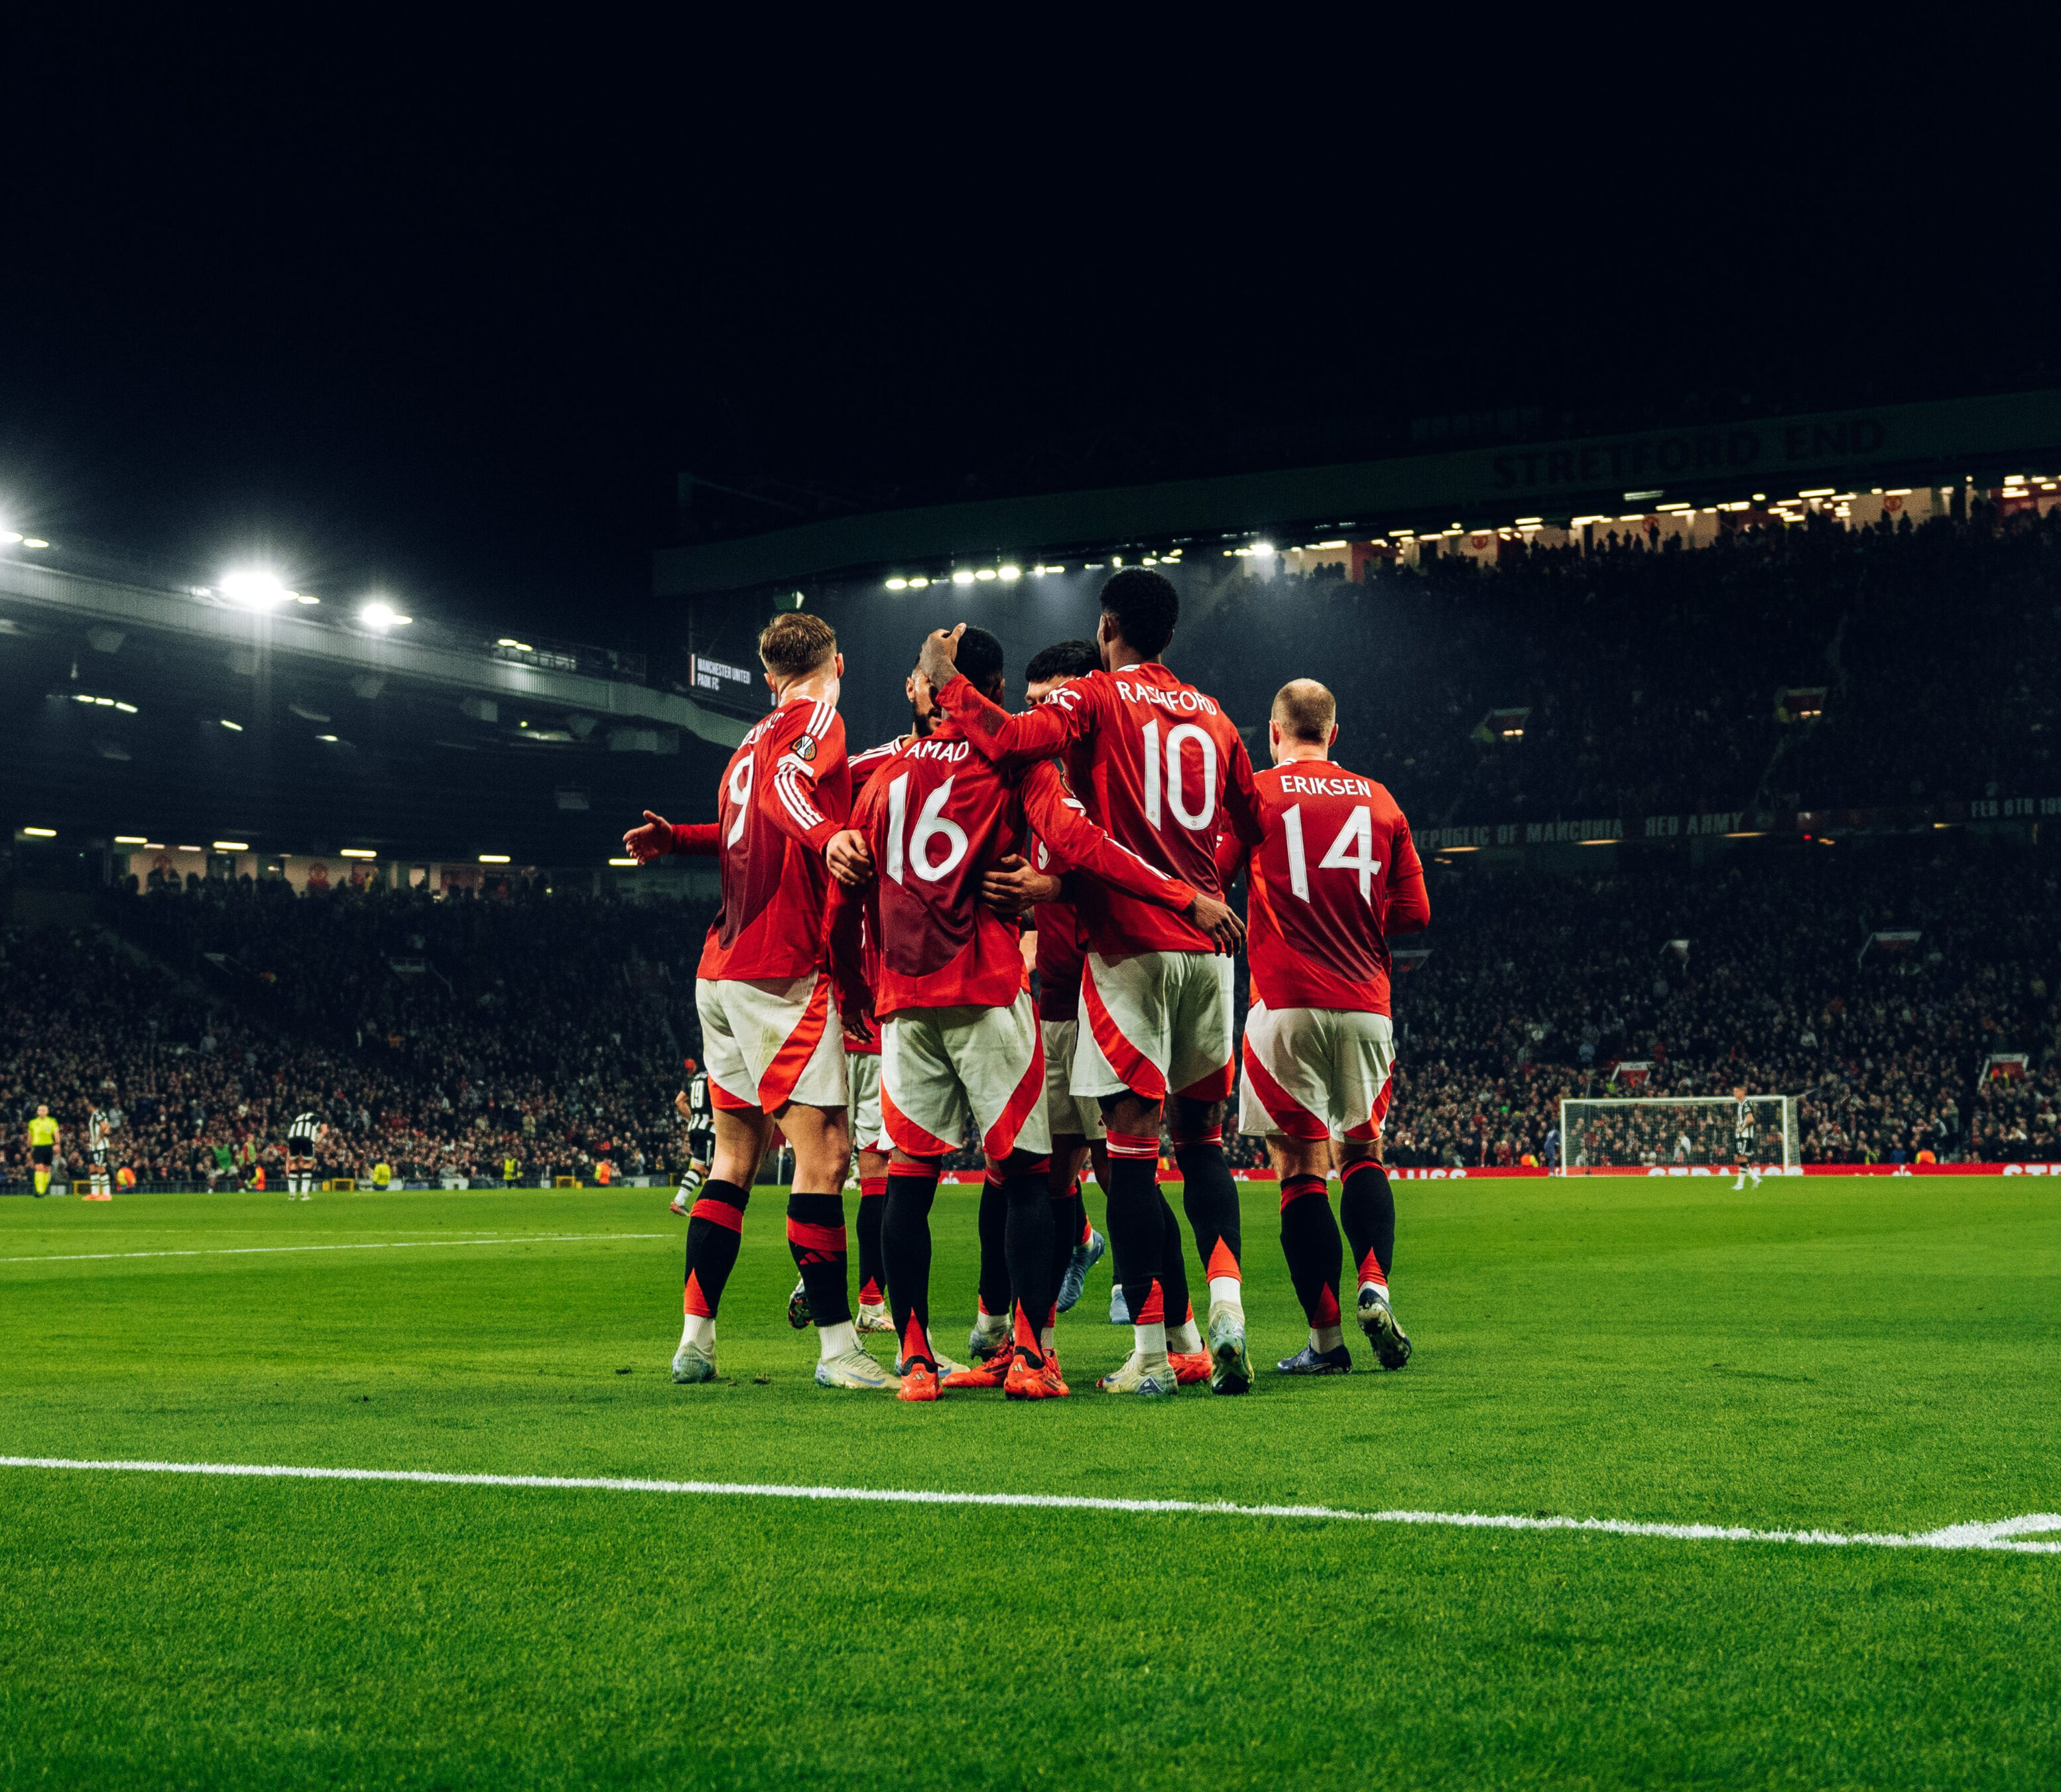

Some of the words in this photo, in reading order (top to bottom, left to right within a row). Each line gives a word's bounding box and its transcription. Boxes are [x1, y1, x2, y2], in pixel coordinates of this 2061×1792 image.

[1493, 430, 1761, 489] STRETFORD
[1786, 418, 1885, 459] END
[697, 657, 731, 679] MANCHESTER
[731, 667, 751, 684] UNITED
[712, 676, 719, 690] FC
[905, 741, 969, 763] AMAD
[1141, 718, 1217, 831] 10
[1280, 775, 1372, 797] ERIKSEN
[727, 751, 755, 850] 9
[1971, 800, 1998, 817] FEB
[886, 771, 969, 886] 16
[1497, 823, 1518, 844] OF
[1281, 803, 1381, 907] 14
[690, 1080, 704, 1109] 19
